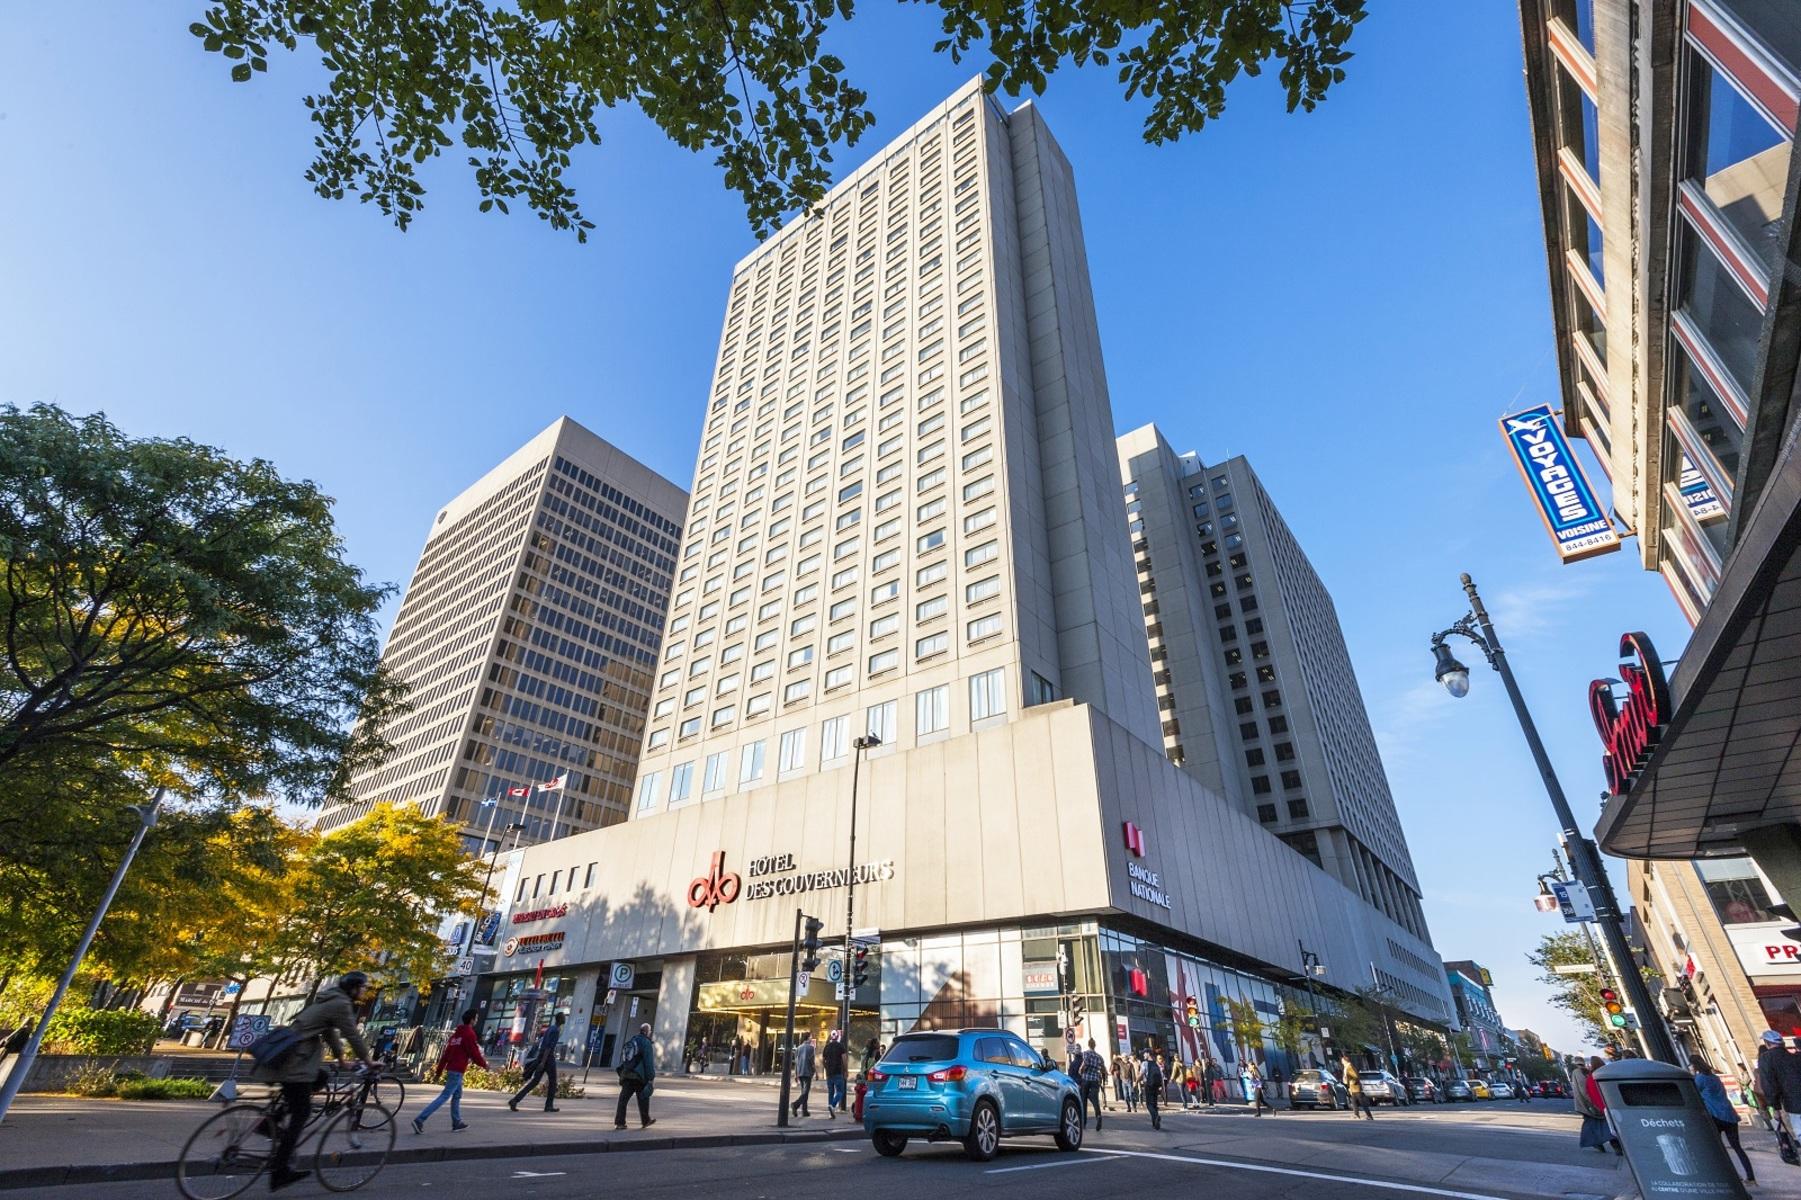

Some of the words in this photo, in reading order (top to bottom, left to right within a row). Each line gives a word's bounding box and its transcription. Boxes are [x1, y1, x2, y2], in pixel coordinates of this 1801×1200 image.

[1521, 429, 1587, 521] VOYAGES
[1556, 520, 1608, 540] VOISINE
[1566, 535, 1612, 551] 844-8416
[749, 853, 796, 877] HÔTEL
[1128, 862, 1160, 888] BANQUE
[745, 880, 774, 900] DES
[775, 860, 894, 896] GOUVERNEURS
[1130, 881, 1172, 910] NATIONALE
[460, 960, 472, 971] 40
[1641, 1118, 1685, 1128] Déchets
